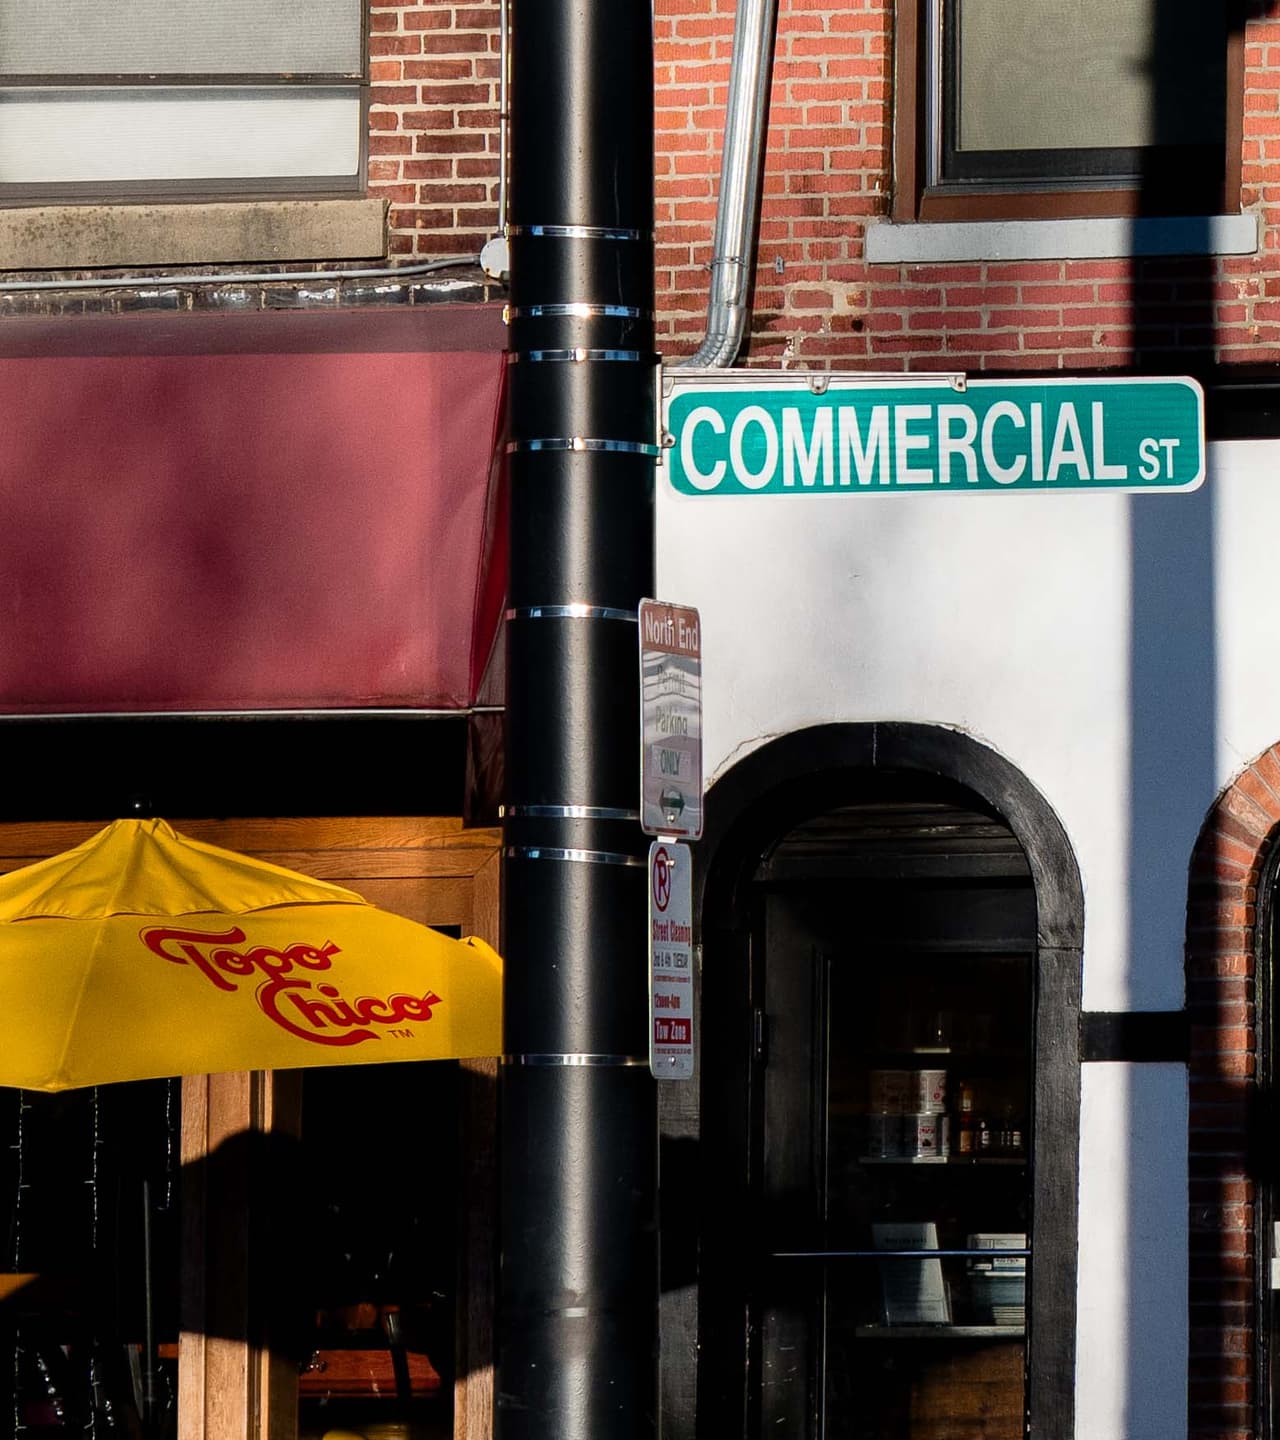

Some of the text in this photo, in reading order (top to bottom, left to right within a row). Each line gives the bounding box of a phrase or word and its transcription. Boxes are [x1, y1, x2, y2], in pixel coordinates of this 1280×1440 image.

[680, 401, 1180, 491] COMMERCIAL ST
[644, 612, 699, 651] North End
[655, 705, 688, 740] Parking
[659, 749, 681, 776] ONLY
[652, 918, 691, 948] Street Cleaning
[138, 924, 342, 992] Topo
[254, 977, 443, 1047] Chico
[655, 1020, 687, 1041] Tow Zone
